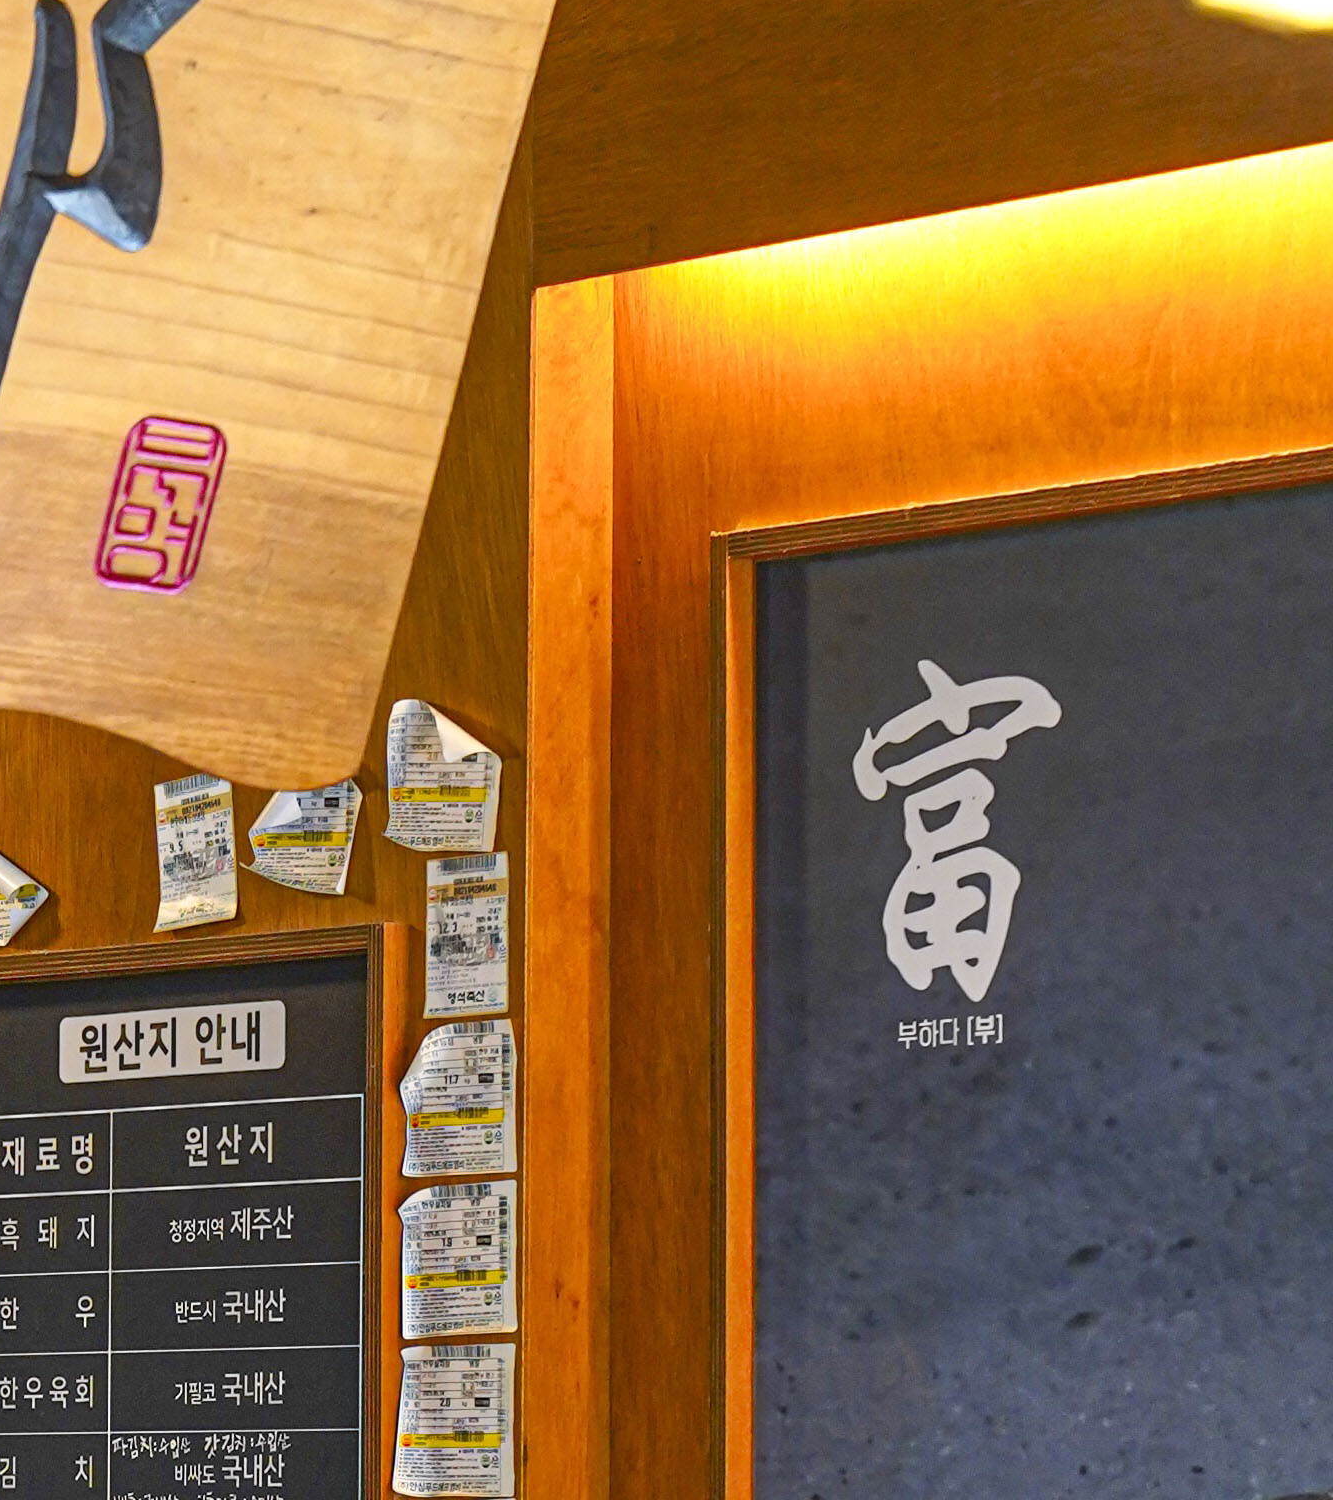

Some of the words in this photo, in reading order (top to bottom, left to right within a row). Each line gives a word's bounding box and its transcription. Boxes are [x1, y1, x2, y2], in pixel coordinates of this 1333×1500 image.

[853, 660, 1062, 1002] 富
[80, 1017, 177, 1074] 원산지
[196, 1011, 261, 1066] 안내
[898, 1018, 960, 1048] 부하다
[967, 1014, 1004, 1045] [부]
[1, 1133, 94, 1176] 재료명
[184, 1122, 274, 1167] 원산지
[169, 1218, 224, 1243] 청정지역
[230, 1205, 294, 1242] 제주산
[175, 1301, 217, 1323] 반드시
[222, 1288, 286, 1325] 국내산
[0, 1375, 94, 1409] 한우육회
[175, 1382, 216, 1404] 기필코
[222, 1371, 285, 1406] 국내산
[175, 1464, 216, 1487] 비싸도
[221, 1453, 285, 1488] 국내산
